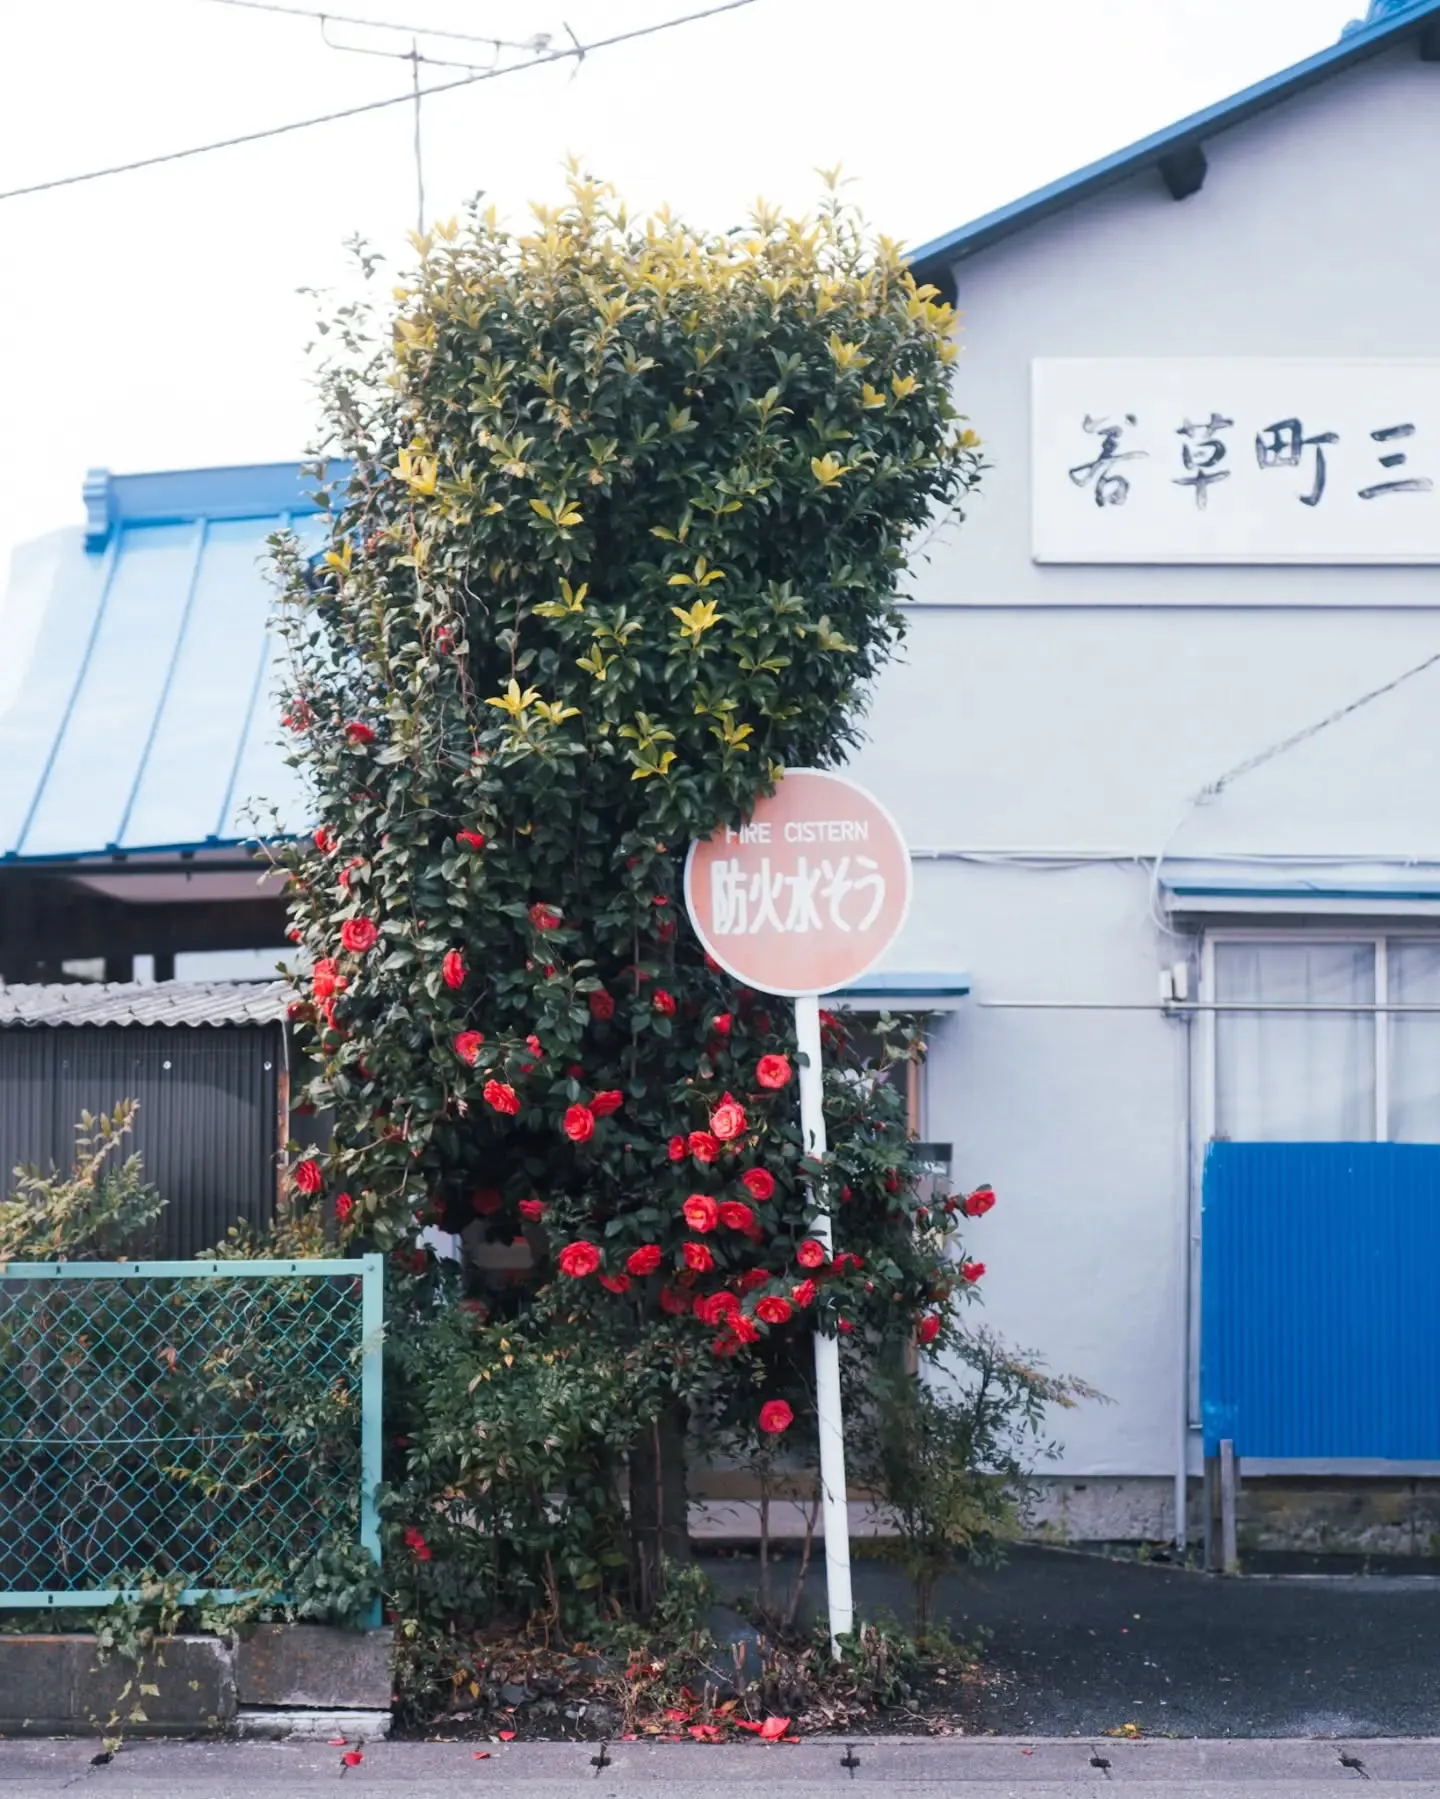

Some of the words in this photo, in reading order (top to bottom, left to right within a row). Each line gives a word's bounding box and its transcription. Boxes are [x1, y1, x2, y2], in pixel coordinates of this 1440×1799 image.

[784, 820, 869, 844] CISTERN
[710, 855, 886, 935] 防火水そう
